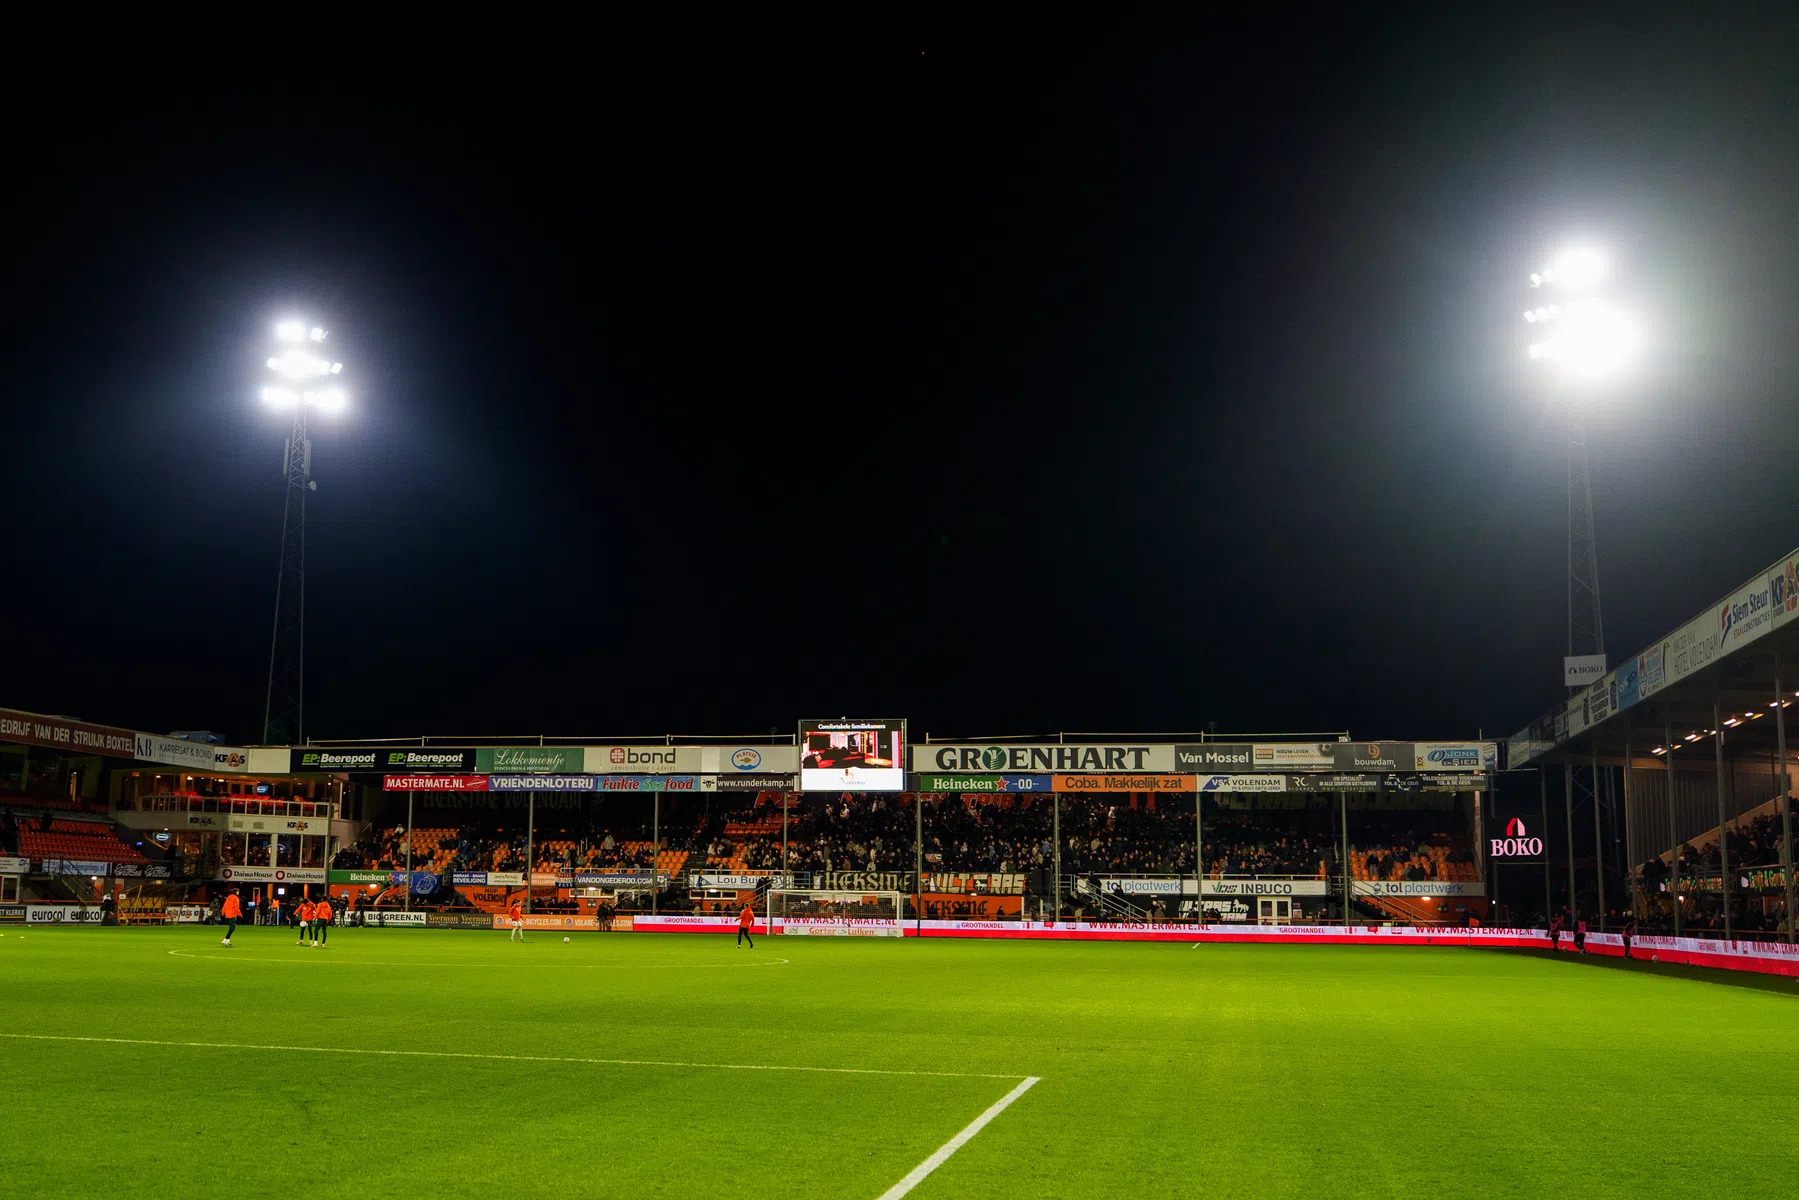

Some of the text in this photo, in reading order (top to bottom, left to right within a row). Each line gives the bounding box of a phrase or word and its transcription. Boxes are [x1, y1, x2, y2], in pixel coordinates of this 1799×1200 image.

[1732, 602, 1749, 625] Siem
[1749, 590, 1768, 614] Steur
[1579, 665, 1603, 674] BOKO
[34, 722, 51, 740] VAN
[53, 726, 71, 743] DER
[73, 730, 105, 748] STRUIJK
[106, 734, 135, 753] BOXTEL
[627, 748, 676, 764] bond
[736, 751, 757, 760] PLATVIS
[1179, 752, 1249, 764] Van Mossel
[1354, 757, 1394, 766] bouwdam
[386, 778, 465, 789] MASTERMATE.NL
[492, 777, 594, 790] VRIENDENLOTERIJ
[602, 776, 694, 792] Fuikie Seafood
[717, 778, 794, 789] www.runderkamp.nl
[933, 778, 993, 790] Heineken
[1065, 776, 1183, 791] Coba. Makkelijk zat
[1211, 778, 1281, 786] VSK VOLENDAM
[1490, 837, 1543, 857] BOKO
[350, 872, 385, 881] Heineken
[717, 875, 737, 884] Lou
[1124, 880, 1181, 893] plaatwerk
[1240, 883, 1292, 894] INBUCO
[1385, 882, 1464, 895] tol plaatwerk
[32, 907, 66, 921] eurocol
[461, 914, 491, 922] Veerman
[783, 916, 897, 926] WWW.MASTERMATE.NL
[1089, 922, 1211, 931] WWW.MASTERMATE.NL
